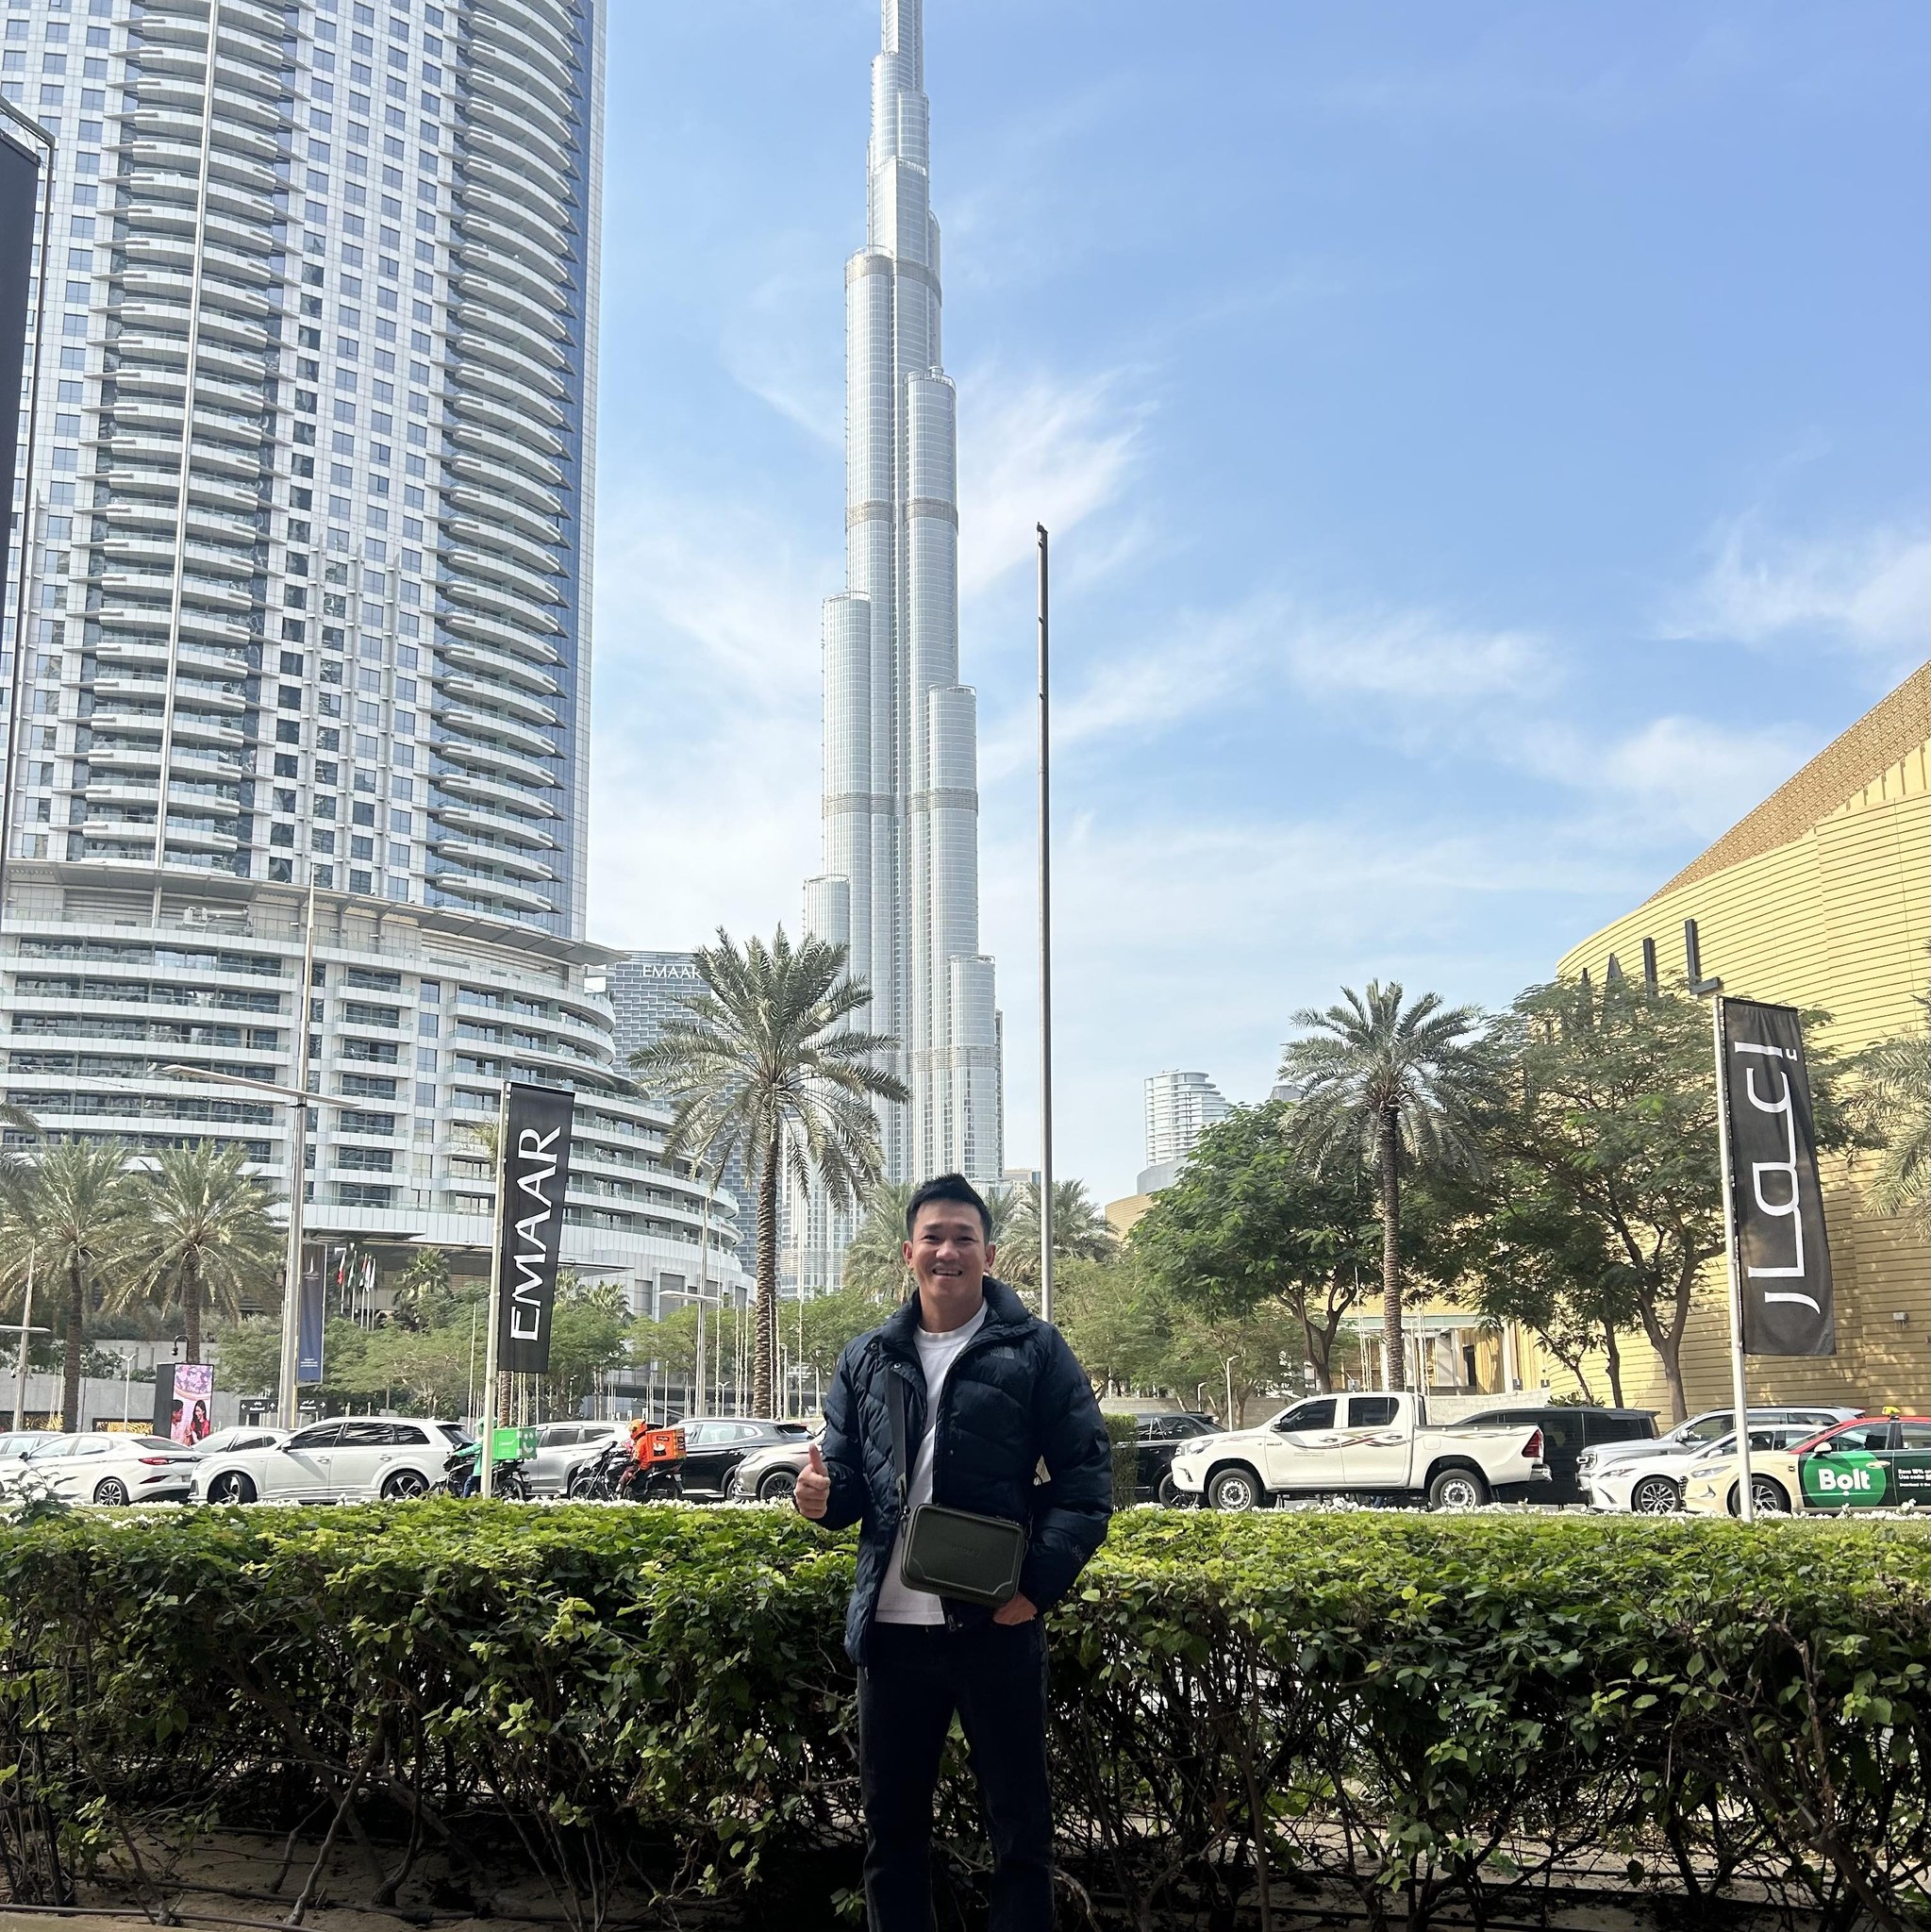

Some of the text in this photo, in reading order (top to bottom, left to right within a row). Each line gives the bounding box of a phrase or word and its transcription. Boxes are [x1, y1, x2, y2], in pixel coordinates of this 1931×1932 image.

[642, 965, 703, 979] EMAAR
[510, 1126, 561, 1341] EMAAR
[1734, 1041, 1822, 1314] إعمار
[1818, 1468, 1872, 1494] Bolt
